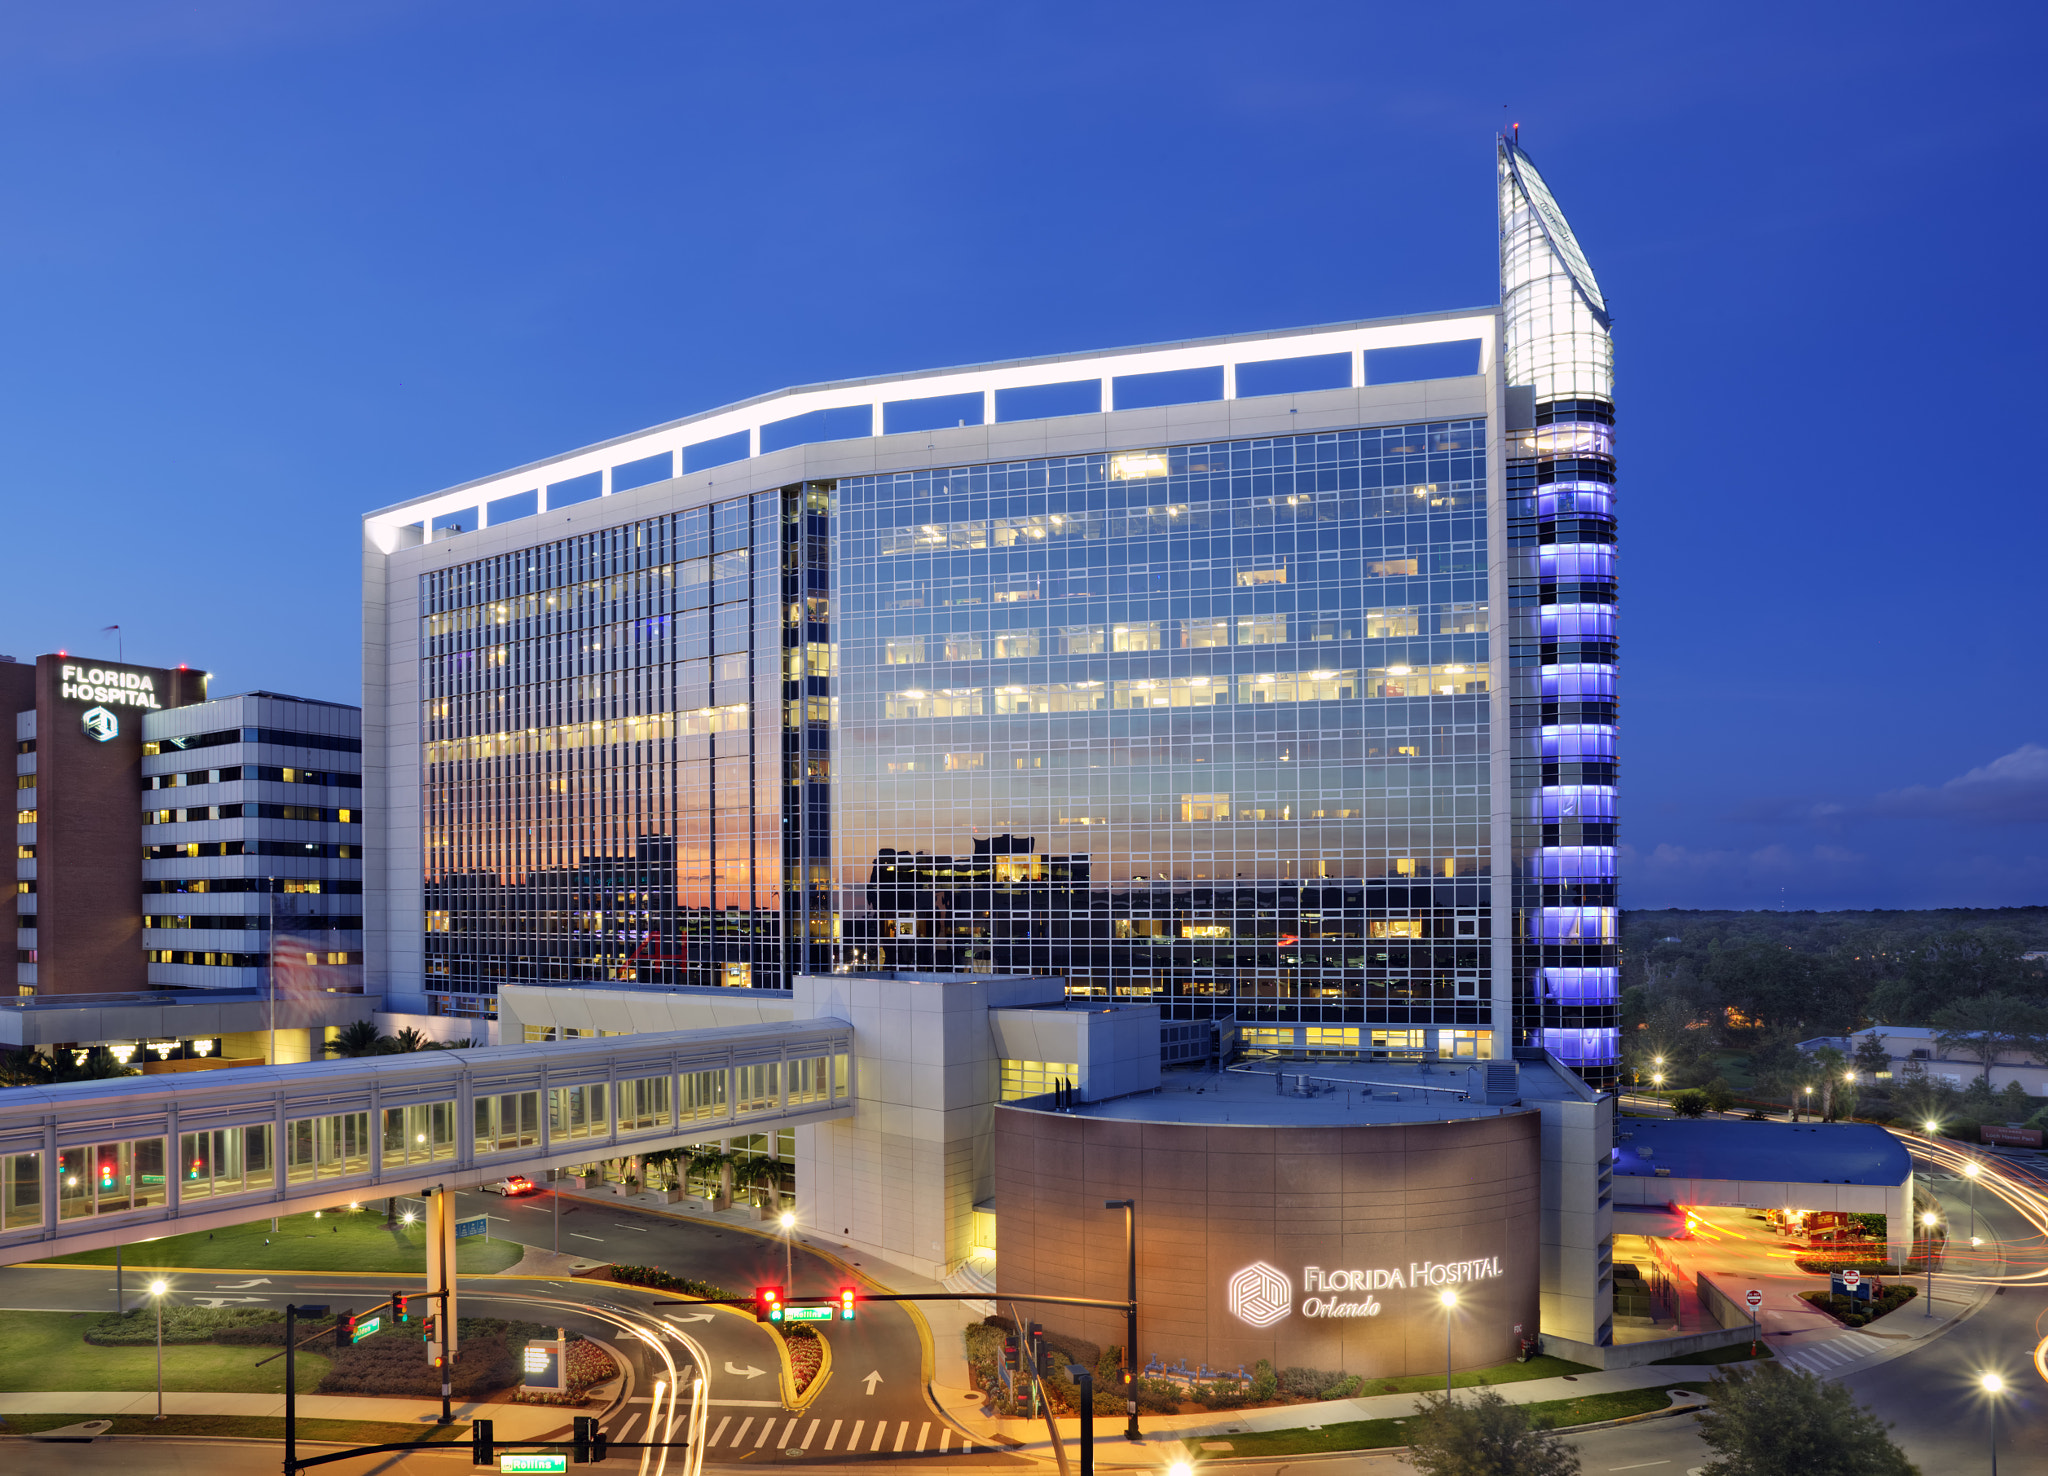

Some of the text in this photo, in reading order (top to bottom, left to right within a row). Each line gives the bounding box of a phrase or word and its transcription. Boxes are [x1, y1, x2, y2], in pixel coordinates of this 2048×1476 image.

[62, 664, 154, 692] FLORIDA
[62, 682, 162, 709] HOSPITAL
[1303, 1256, 1505, 1292] FLORIDA HOSPITAL
[1302, 1295, 1381, 1319] Orlando
[513, 1459, 552, 1469] Rollins
